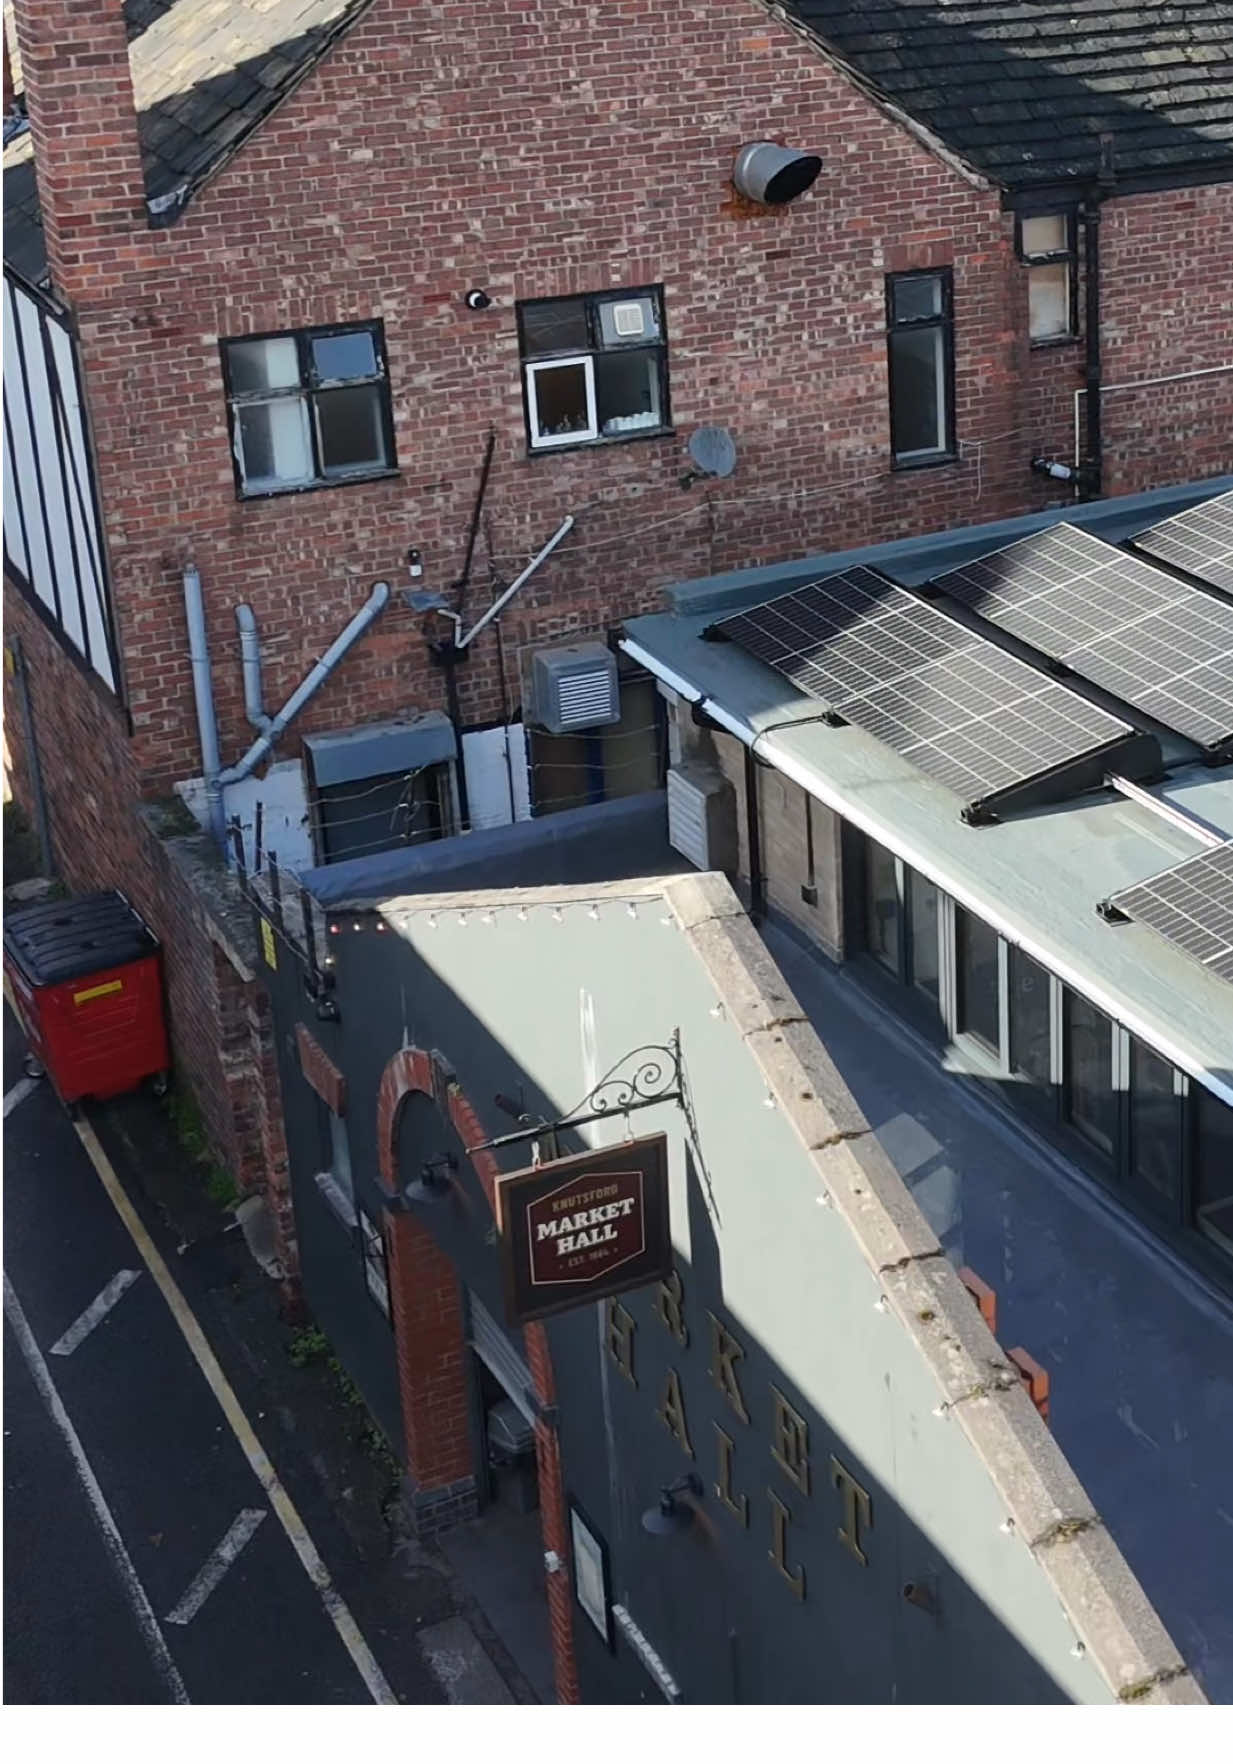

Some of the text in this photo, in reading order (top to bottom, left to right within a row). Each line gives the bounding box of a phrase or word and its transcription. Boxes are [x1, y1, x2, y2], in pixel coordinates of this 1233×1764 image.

[537, 1198, 634, 1241] MARKET
[552, 1185, 618, 1212] KNUTSFORD
[556, 1225, 618, 1256] HALL
[651, 1270, 871, 1566] RKET
[604, 1296, 807, 1600] HALL
